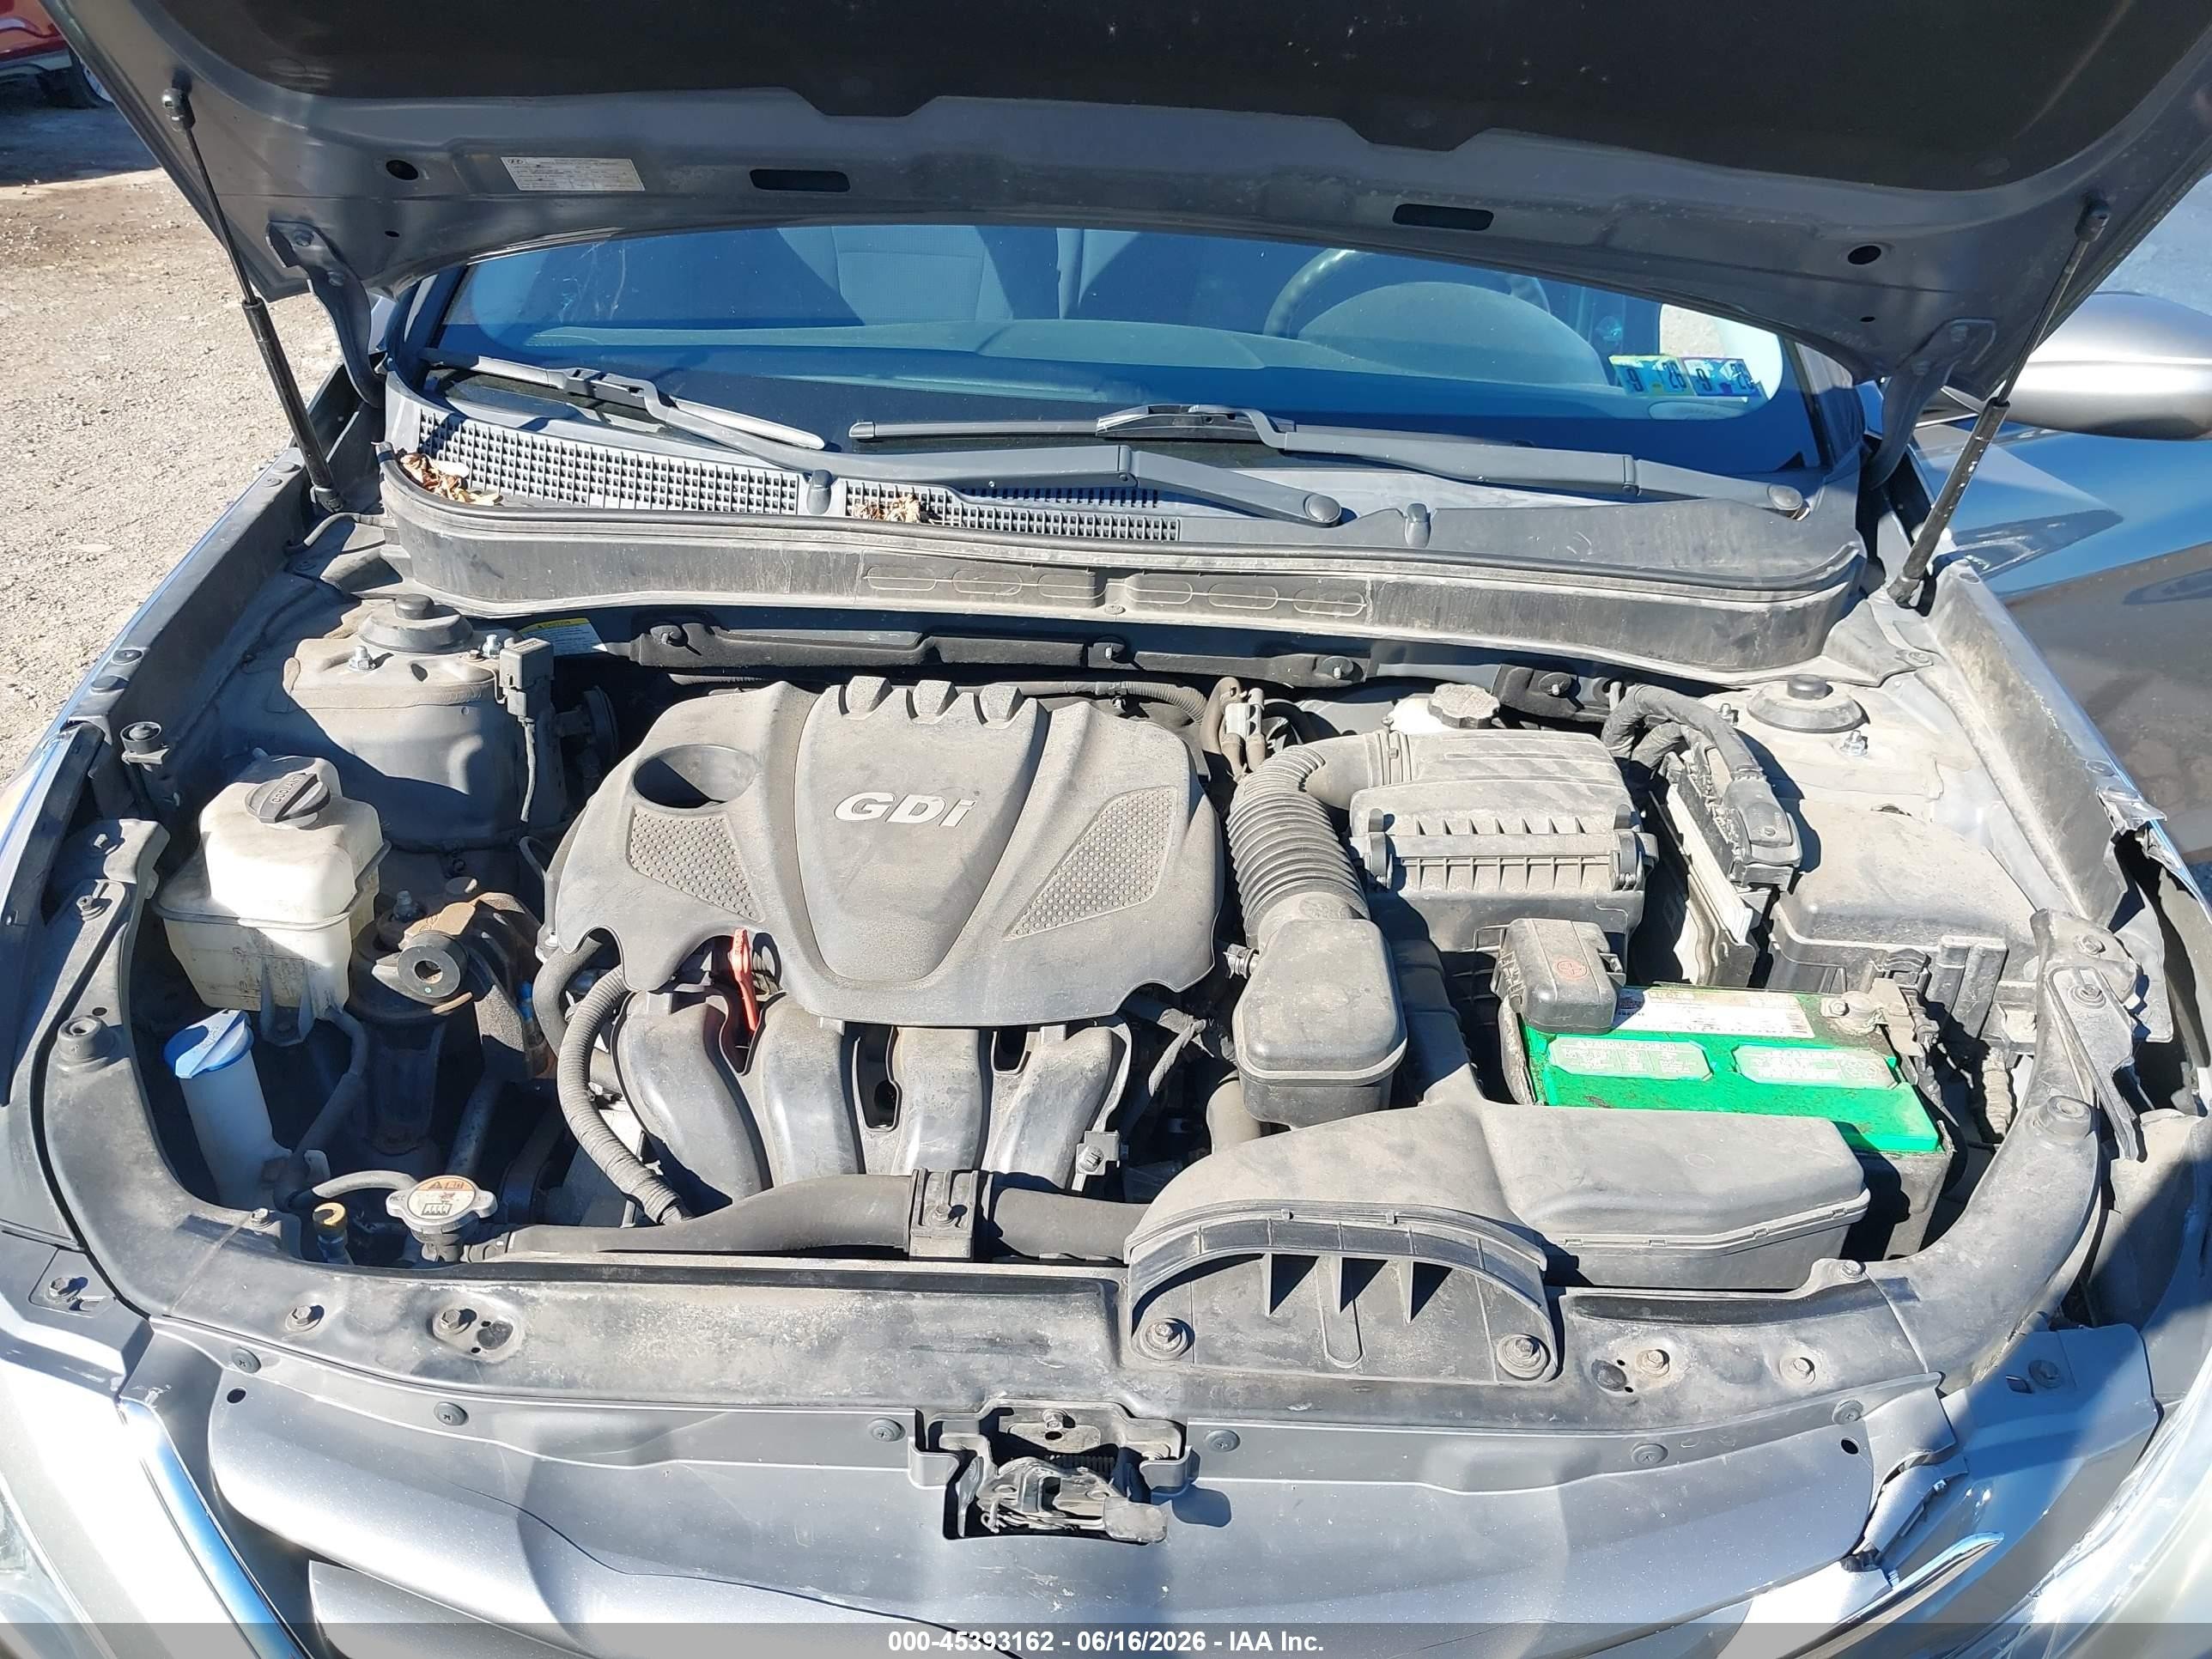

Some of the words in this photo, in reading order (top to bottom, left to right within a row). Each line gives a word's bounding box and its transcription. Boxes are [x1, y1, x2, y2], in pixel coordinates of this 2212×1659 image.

[1626, 368, 1644, 392] 9
[1695, 368, 1713, 392] 9
[270, 775, 303, 804] COOLANT
[834, 792, 977, 827] GDi
